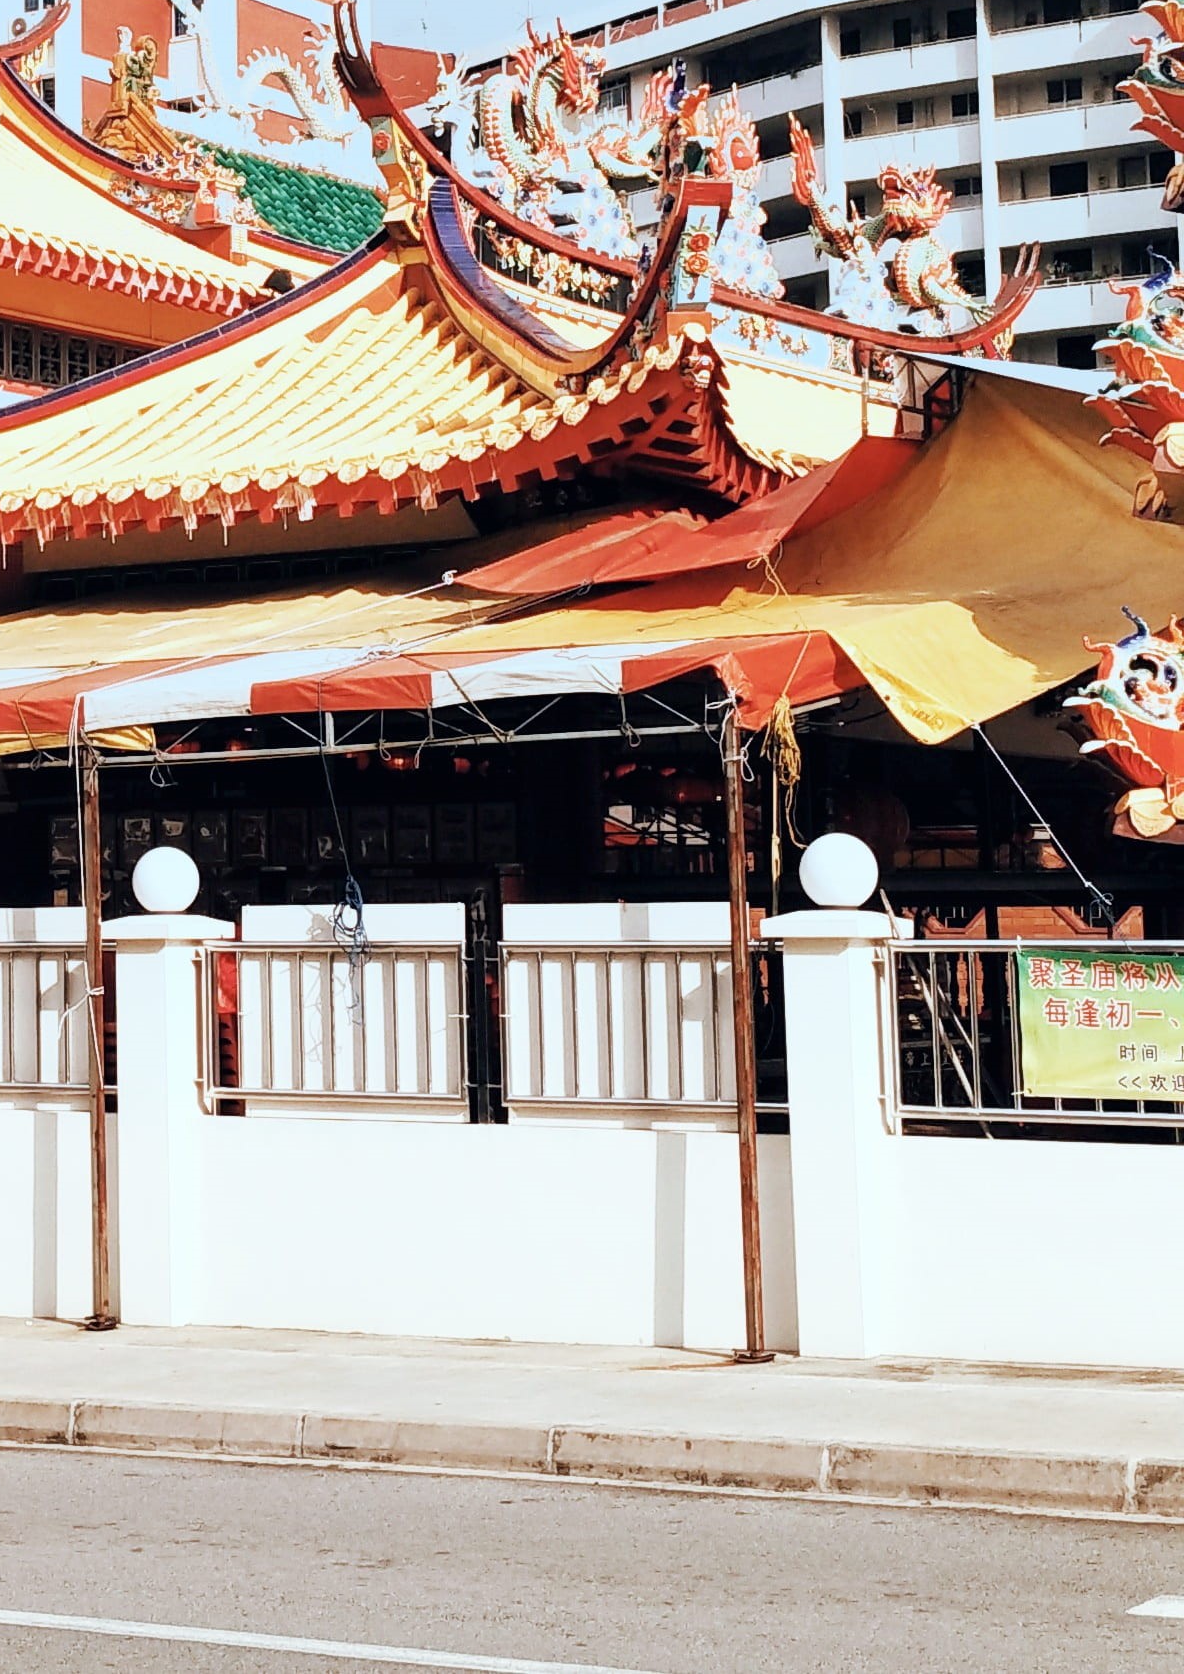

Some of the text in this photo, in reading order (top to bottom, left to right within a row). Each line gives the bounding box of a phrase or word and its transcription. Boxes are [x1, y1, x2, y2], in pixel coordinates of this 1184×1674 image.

[1030, 958, 1180, 989] 聚圣庙将从
